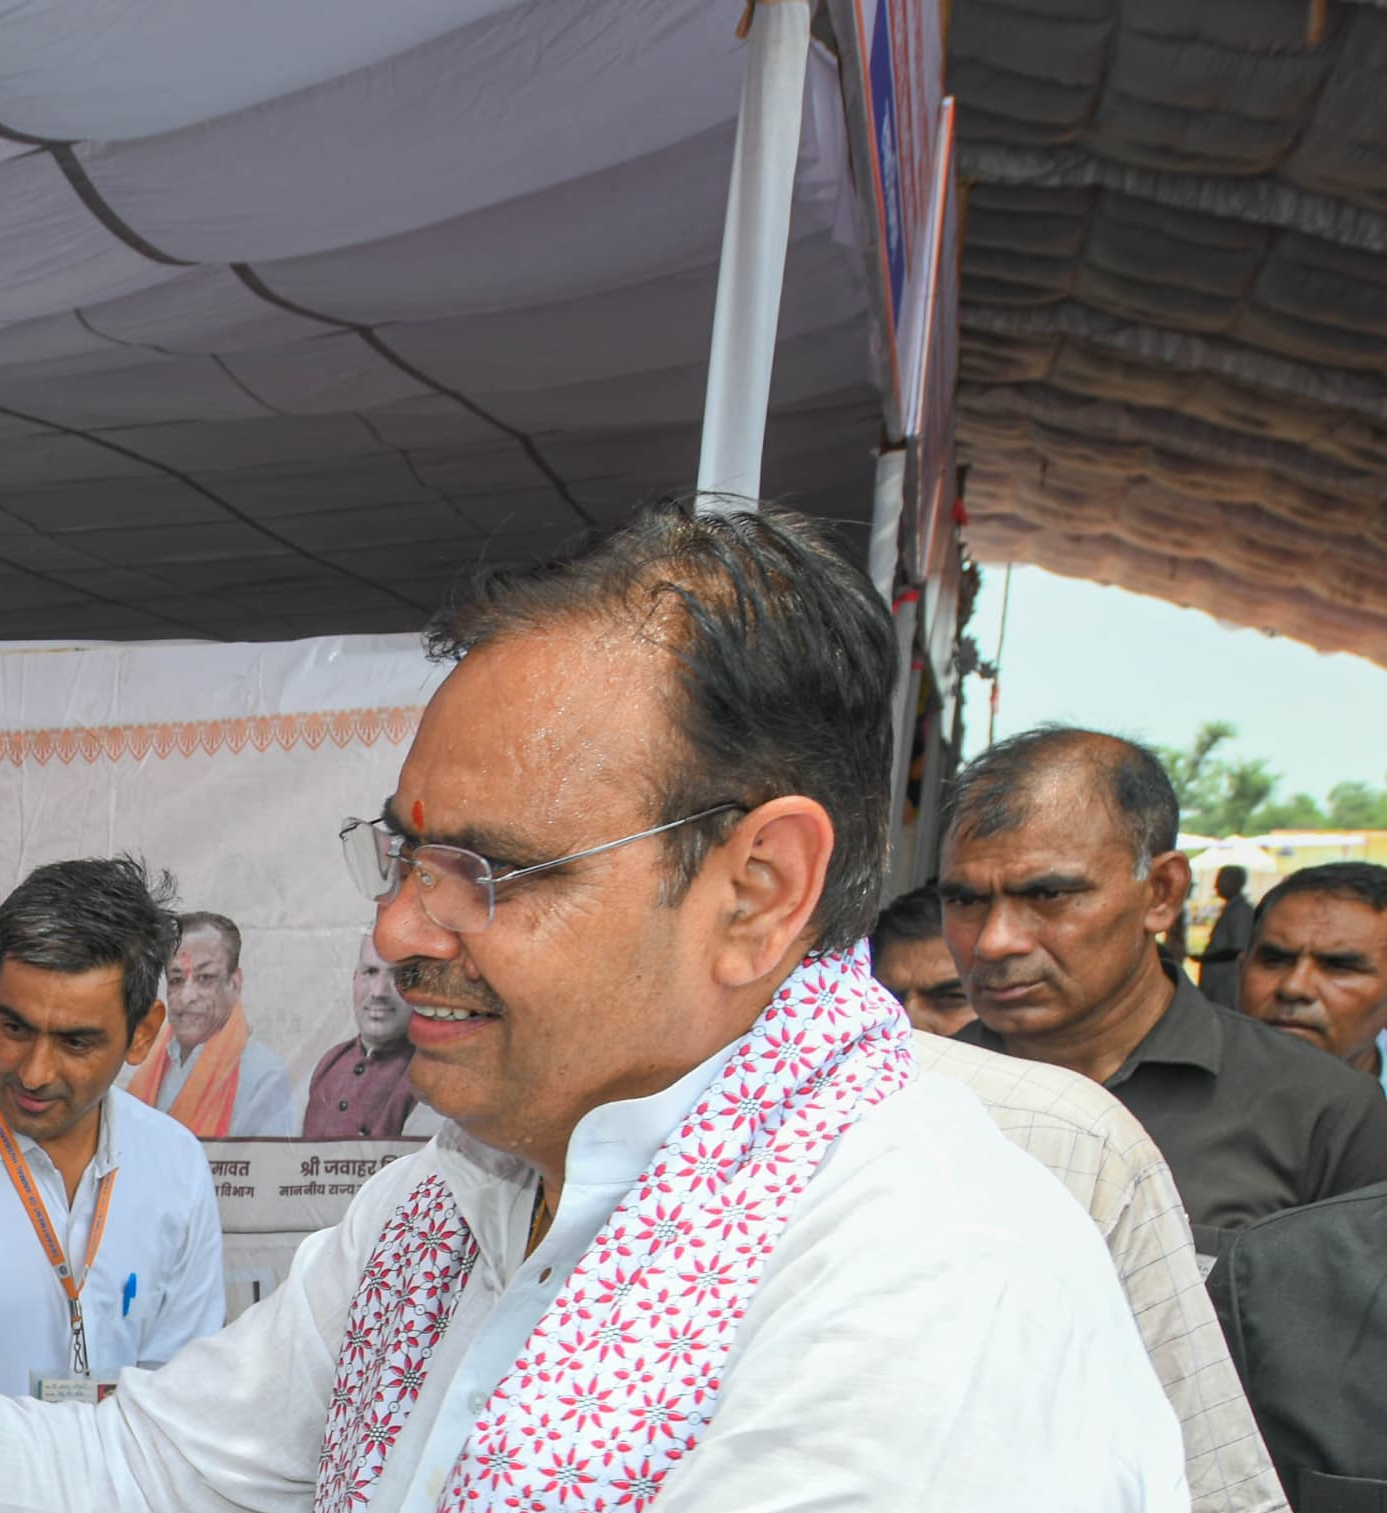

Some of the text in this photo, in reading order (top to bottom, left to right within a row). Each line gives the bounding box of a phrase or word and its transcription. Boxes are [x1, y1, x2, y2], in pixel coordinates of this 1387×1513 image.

[208, 1160, 251, 1176] मावत
[300, 1156, 320, 1177] श्री
[324, 1159, 377, 1177] जवाहर
[221, 1182, 255, 1198] विभाग
[279, 1181, 325, 1197] माननीय
[328, 1184, 355, 1195] राज्य
